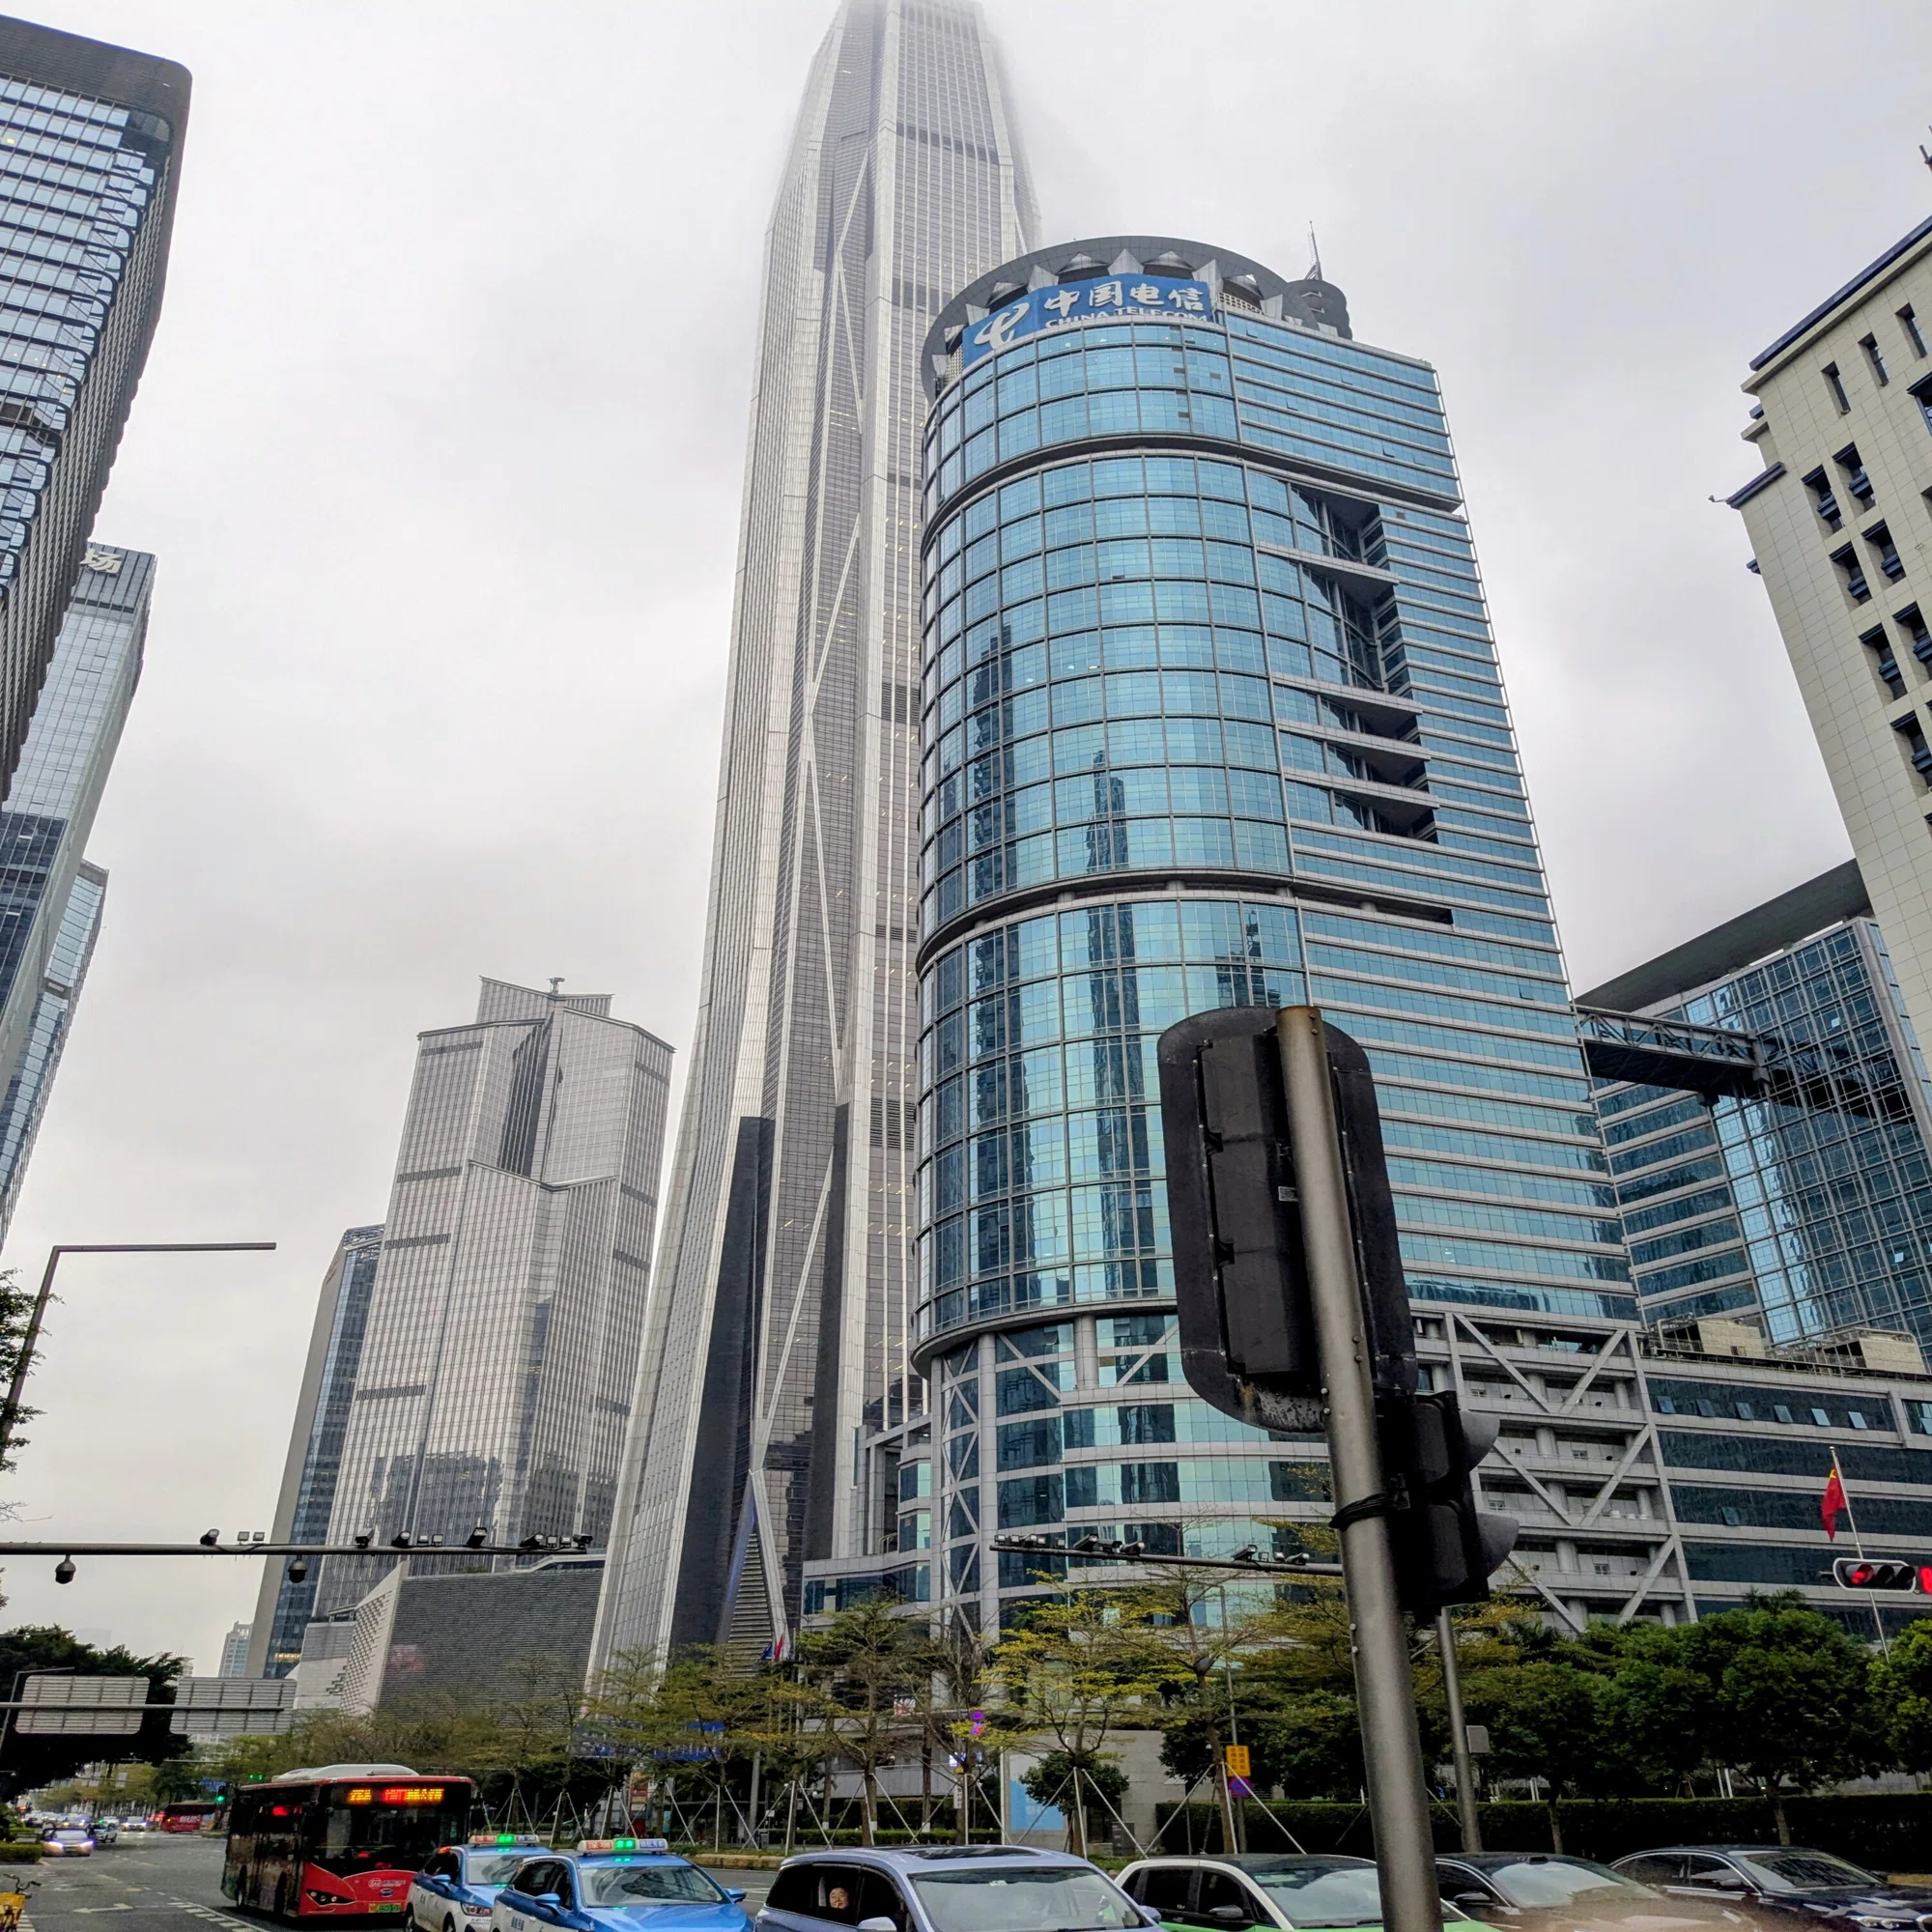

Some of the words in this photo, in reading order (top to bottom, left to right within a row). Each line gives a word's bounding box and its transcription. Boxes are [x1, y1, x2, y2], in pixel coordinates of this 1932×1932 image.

[1043, 280, 1205, 317] 中国电信
[1045, 310, 1110, 328] CHINA
[1114, 305, 1208, 322] TELECOM
[79, 548, 122, 574] 场
